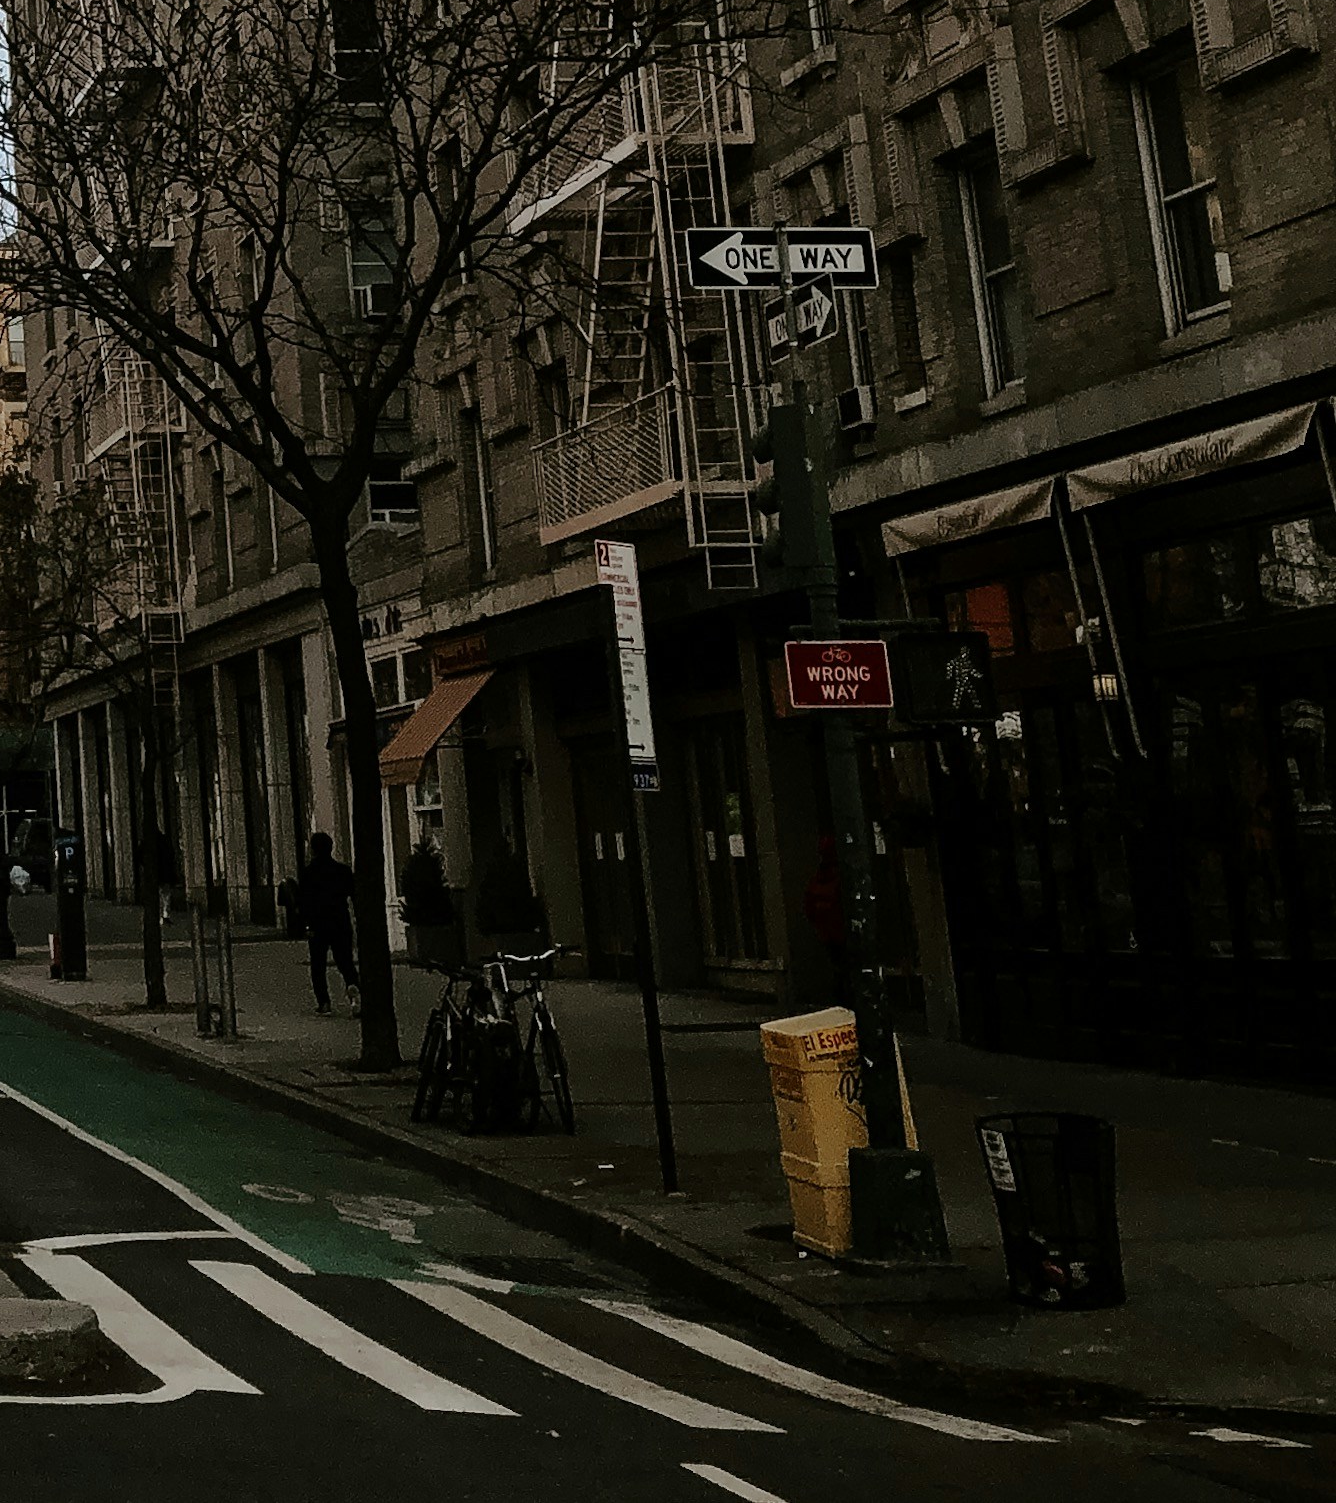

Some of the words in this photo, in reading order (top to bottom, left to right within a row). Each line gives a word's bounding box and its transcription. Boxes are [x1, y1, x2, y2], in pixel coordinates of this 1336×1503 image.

[725, 247, 774, 270] ONE
[799, 247, 852, 269] WAY
[803, 296, 823, 326] WAY
[806, 665, 871, 682] WRONG
[820, 683, 860, 700] WAY
[802, 1035, 816, 1052] El
[817, 1028, 858, 1050] Espec
